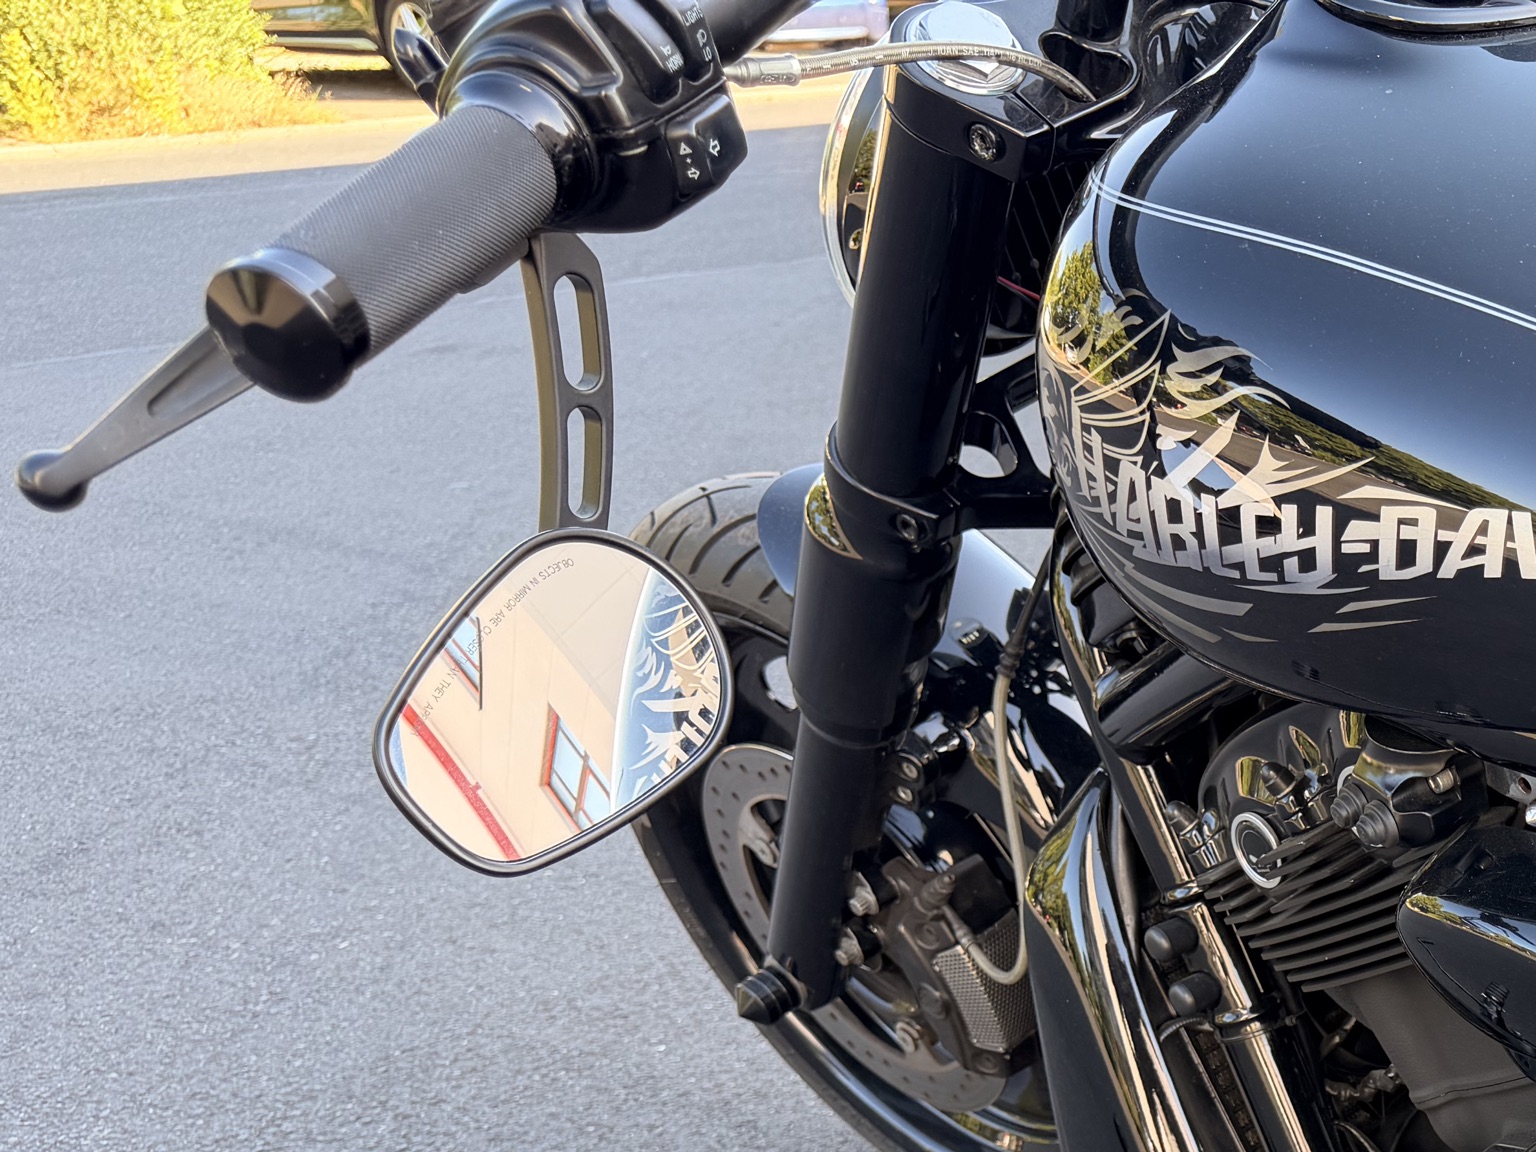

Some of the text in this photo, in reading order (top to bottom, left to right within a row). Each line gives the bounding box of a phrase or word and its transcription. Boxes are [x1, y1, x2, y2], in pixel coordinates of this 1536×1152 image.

[538, 558, 575, 581] OBJECTS
[529, 576, 540, 588] IN
[503, 584, 532, 612] MIRROR
[488, 609, 506, 627] ARE
[431, 679, 452, 703] THEY
